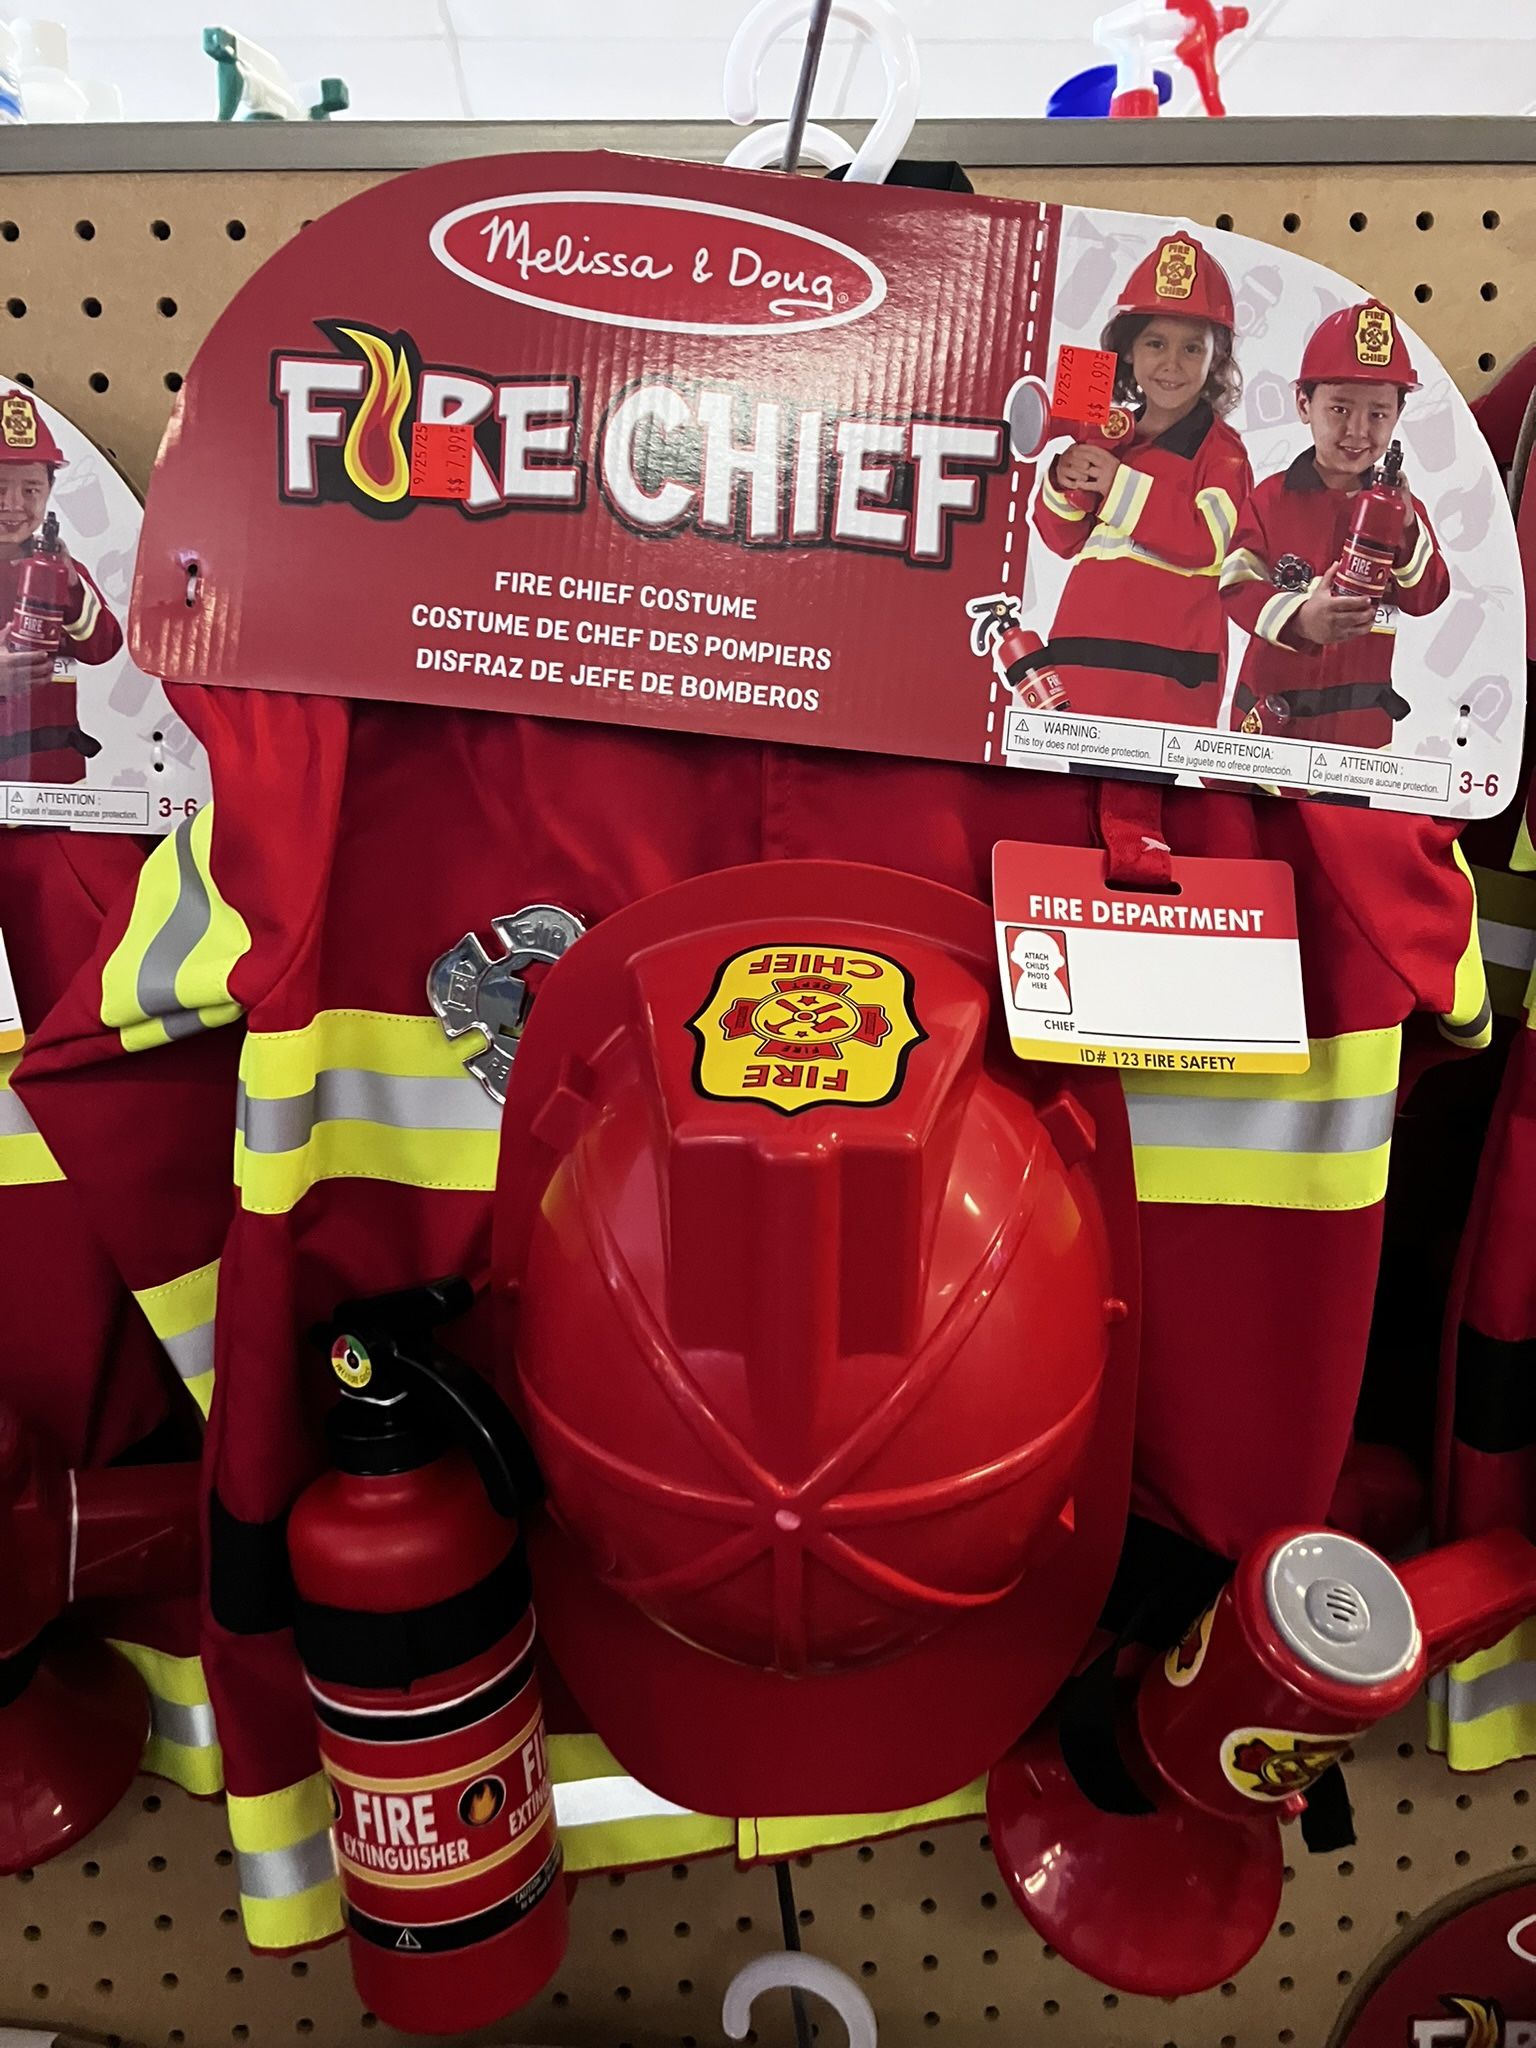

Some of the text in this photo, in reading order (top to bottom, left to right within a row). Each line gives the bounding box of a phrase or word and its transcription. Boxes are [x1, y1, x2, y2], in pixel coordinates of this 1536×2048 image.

[480, 215, 834, 316] Melissa & Doug
[1365, 310, 1386, 321] FIRE
[1360, 352, 1388, 363] CHIEF
[1055, 347, 1075, 406] 9/25/25
[413, 425, 428, 485] 9/25/25
[602, 383, 1002, 558] CHIEF
[1350, 556, 1372, 575] FIRE
[495, 571, 758, 620] FIRE CHIEF COSTUME
[23, 616, 43, 633] FIRE
[411, 604, 832, 671] COSTUME DE CHEF DES POMPIERS
[416, 648, 820, 711] DISFRAZ DE JEFE DE BOMBEROS
[1044, 721, 1101, 740] WARNING:
[1014, 734, 1152, 760] This toy does not provide protection.
[1194, 739, 1274, 761] ADVERTENCIA:
[1167, 752, 1185, 764] Este
[1186, 755, 1214, 768] juguete
[1216, 759, 1226, 769] no
[1227, 759, 1251, 772] ofrece
[1340, 756, 1399, 776] ATTENTION
[1312, 769, 1440, 794] Ce jouet n'assure aucune protection.
[1459, 770, 1499, 797] 3-6
[36, 792, 96, 806] ATTENTION
[159, 796, 198, 818] 3-6
[10, 805, 21, 815] Ce
[22, 806, 40, 817] jouet
[74, 809, 100, 818] aucune
[1029, 894, 1264, 932] FIRE DEPARTMENT
[748, 953, 884, 980] CHIEF
[1024, 952, 1049, 961] ATTACH
[1027, 971, 1050, 980] PHOTO
[1031, 981, 1048, 990] HERE
[1044, 1019, 1076, 1033] CHIEF
[1079, 1048, 1236, 1071] ID# 123 FIRE SAFETY
[741, 1063, 849, 1092] FIRE
[353, 1789, 438, 1846] FIRE
[343, 1832, 470, 1872] EXTINGUISHER
